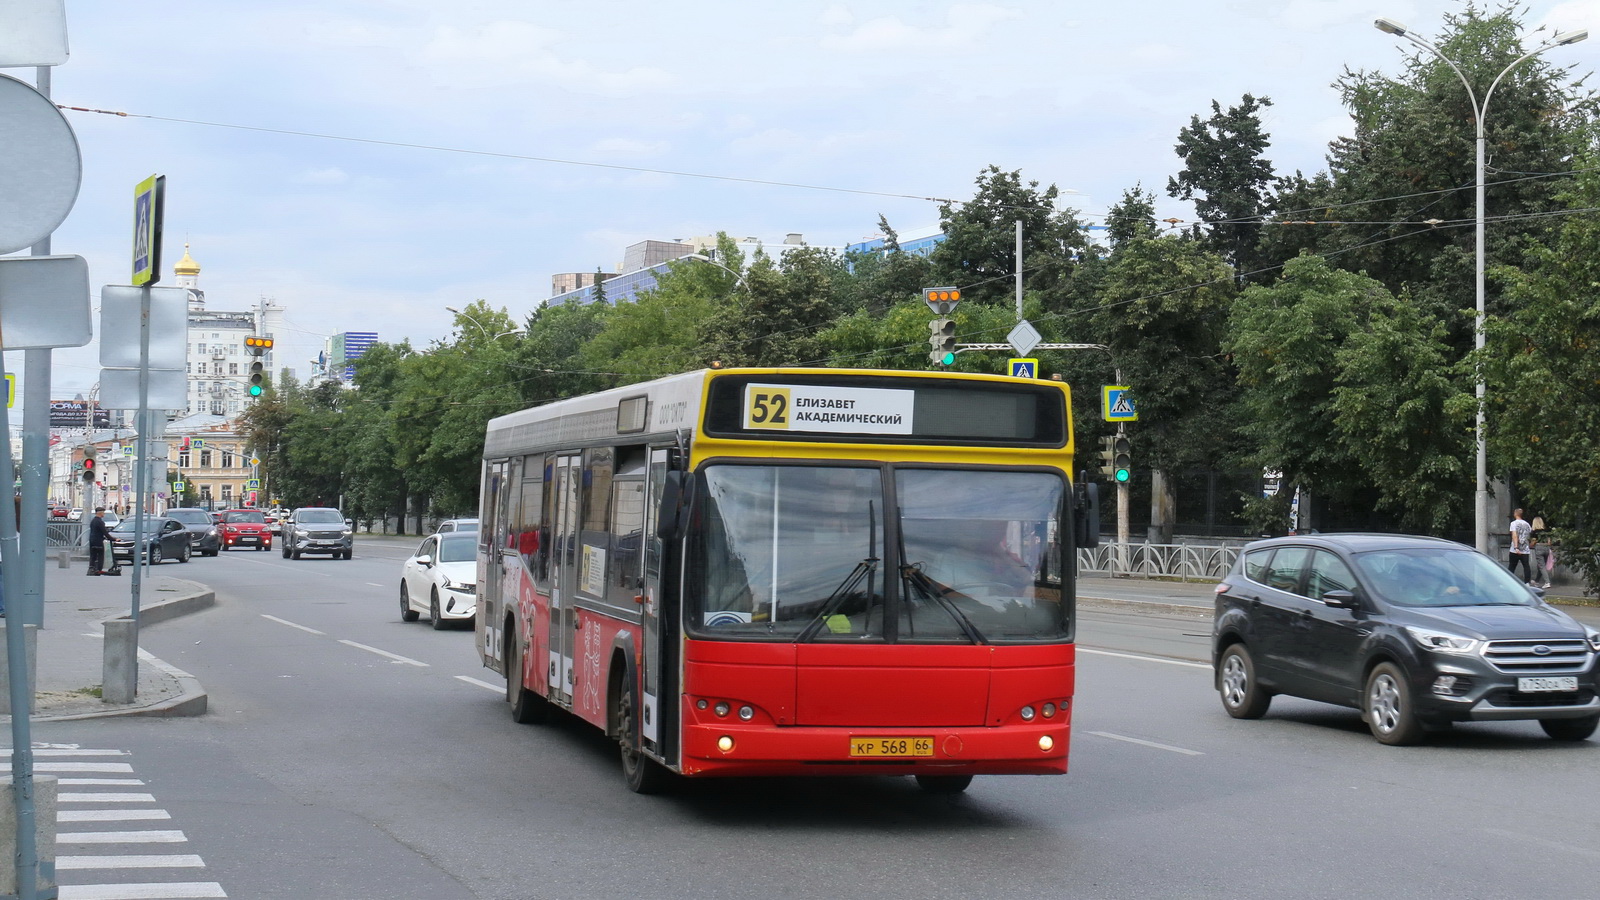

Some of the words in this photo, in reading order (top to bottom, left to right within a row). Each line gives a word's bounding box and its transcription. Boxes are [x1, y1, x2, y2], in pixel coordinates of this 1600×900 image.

[752, 394, 786, 424] 52
[796, 397, 856, 410] ЕЛИЗАВЕТ
[796, 412, 902, 426] АКАДЕМИЧЕСКИЙ
[858, 744, 874, 754] КР
[881, 740, 906, 754] 568
[915, 740, 928, 750] 66
